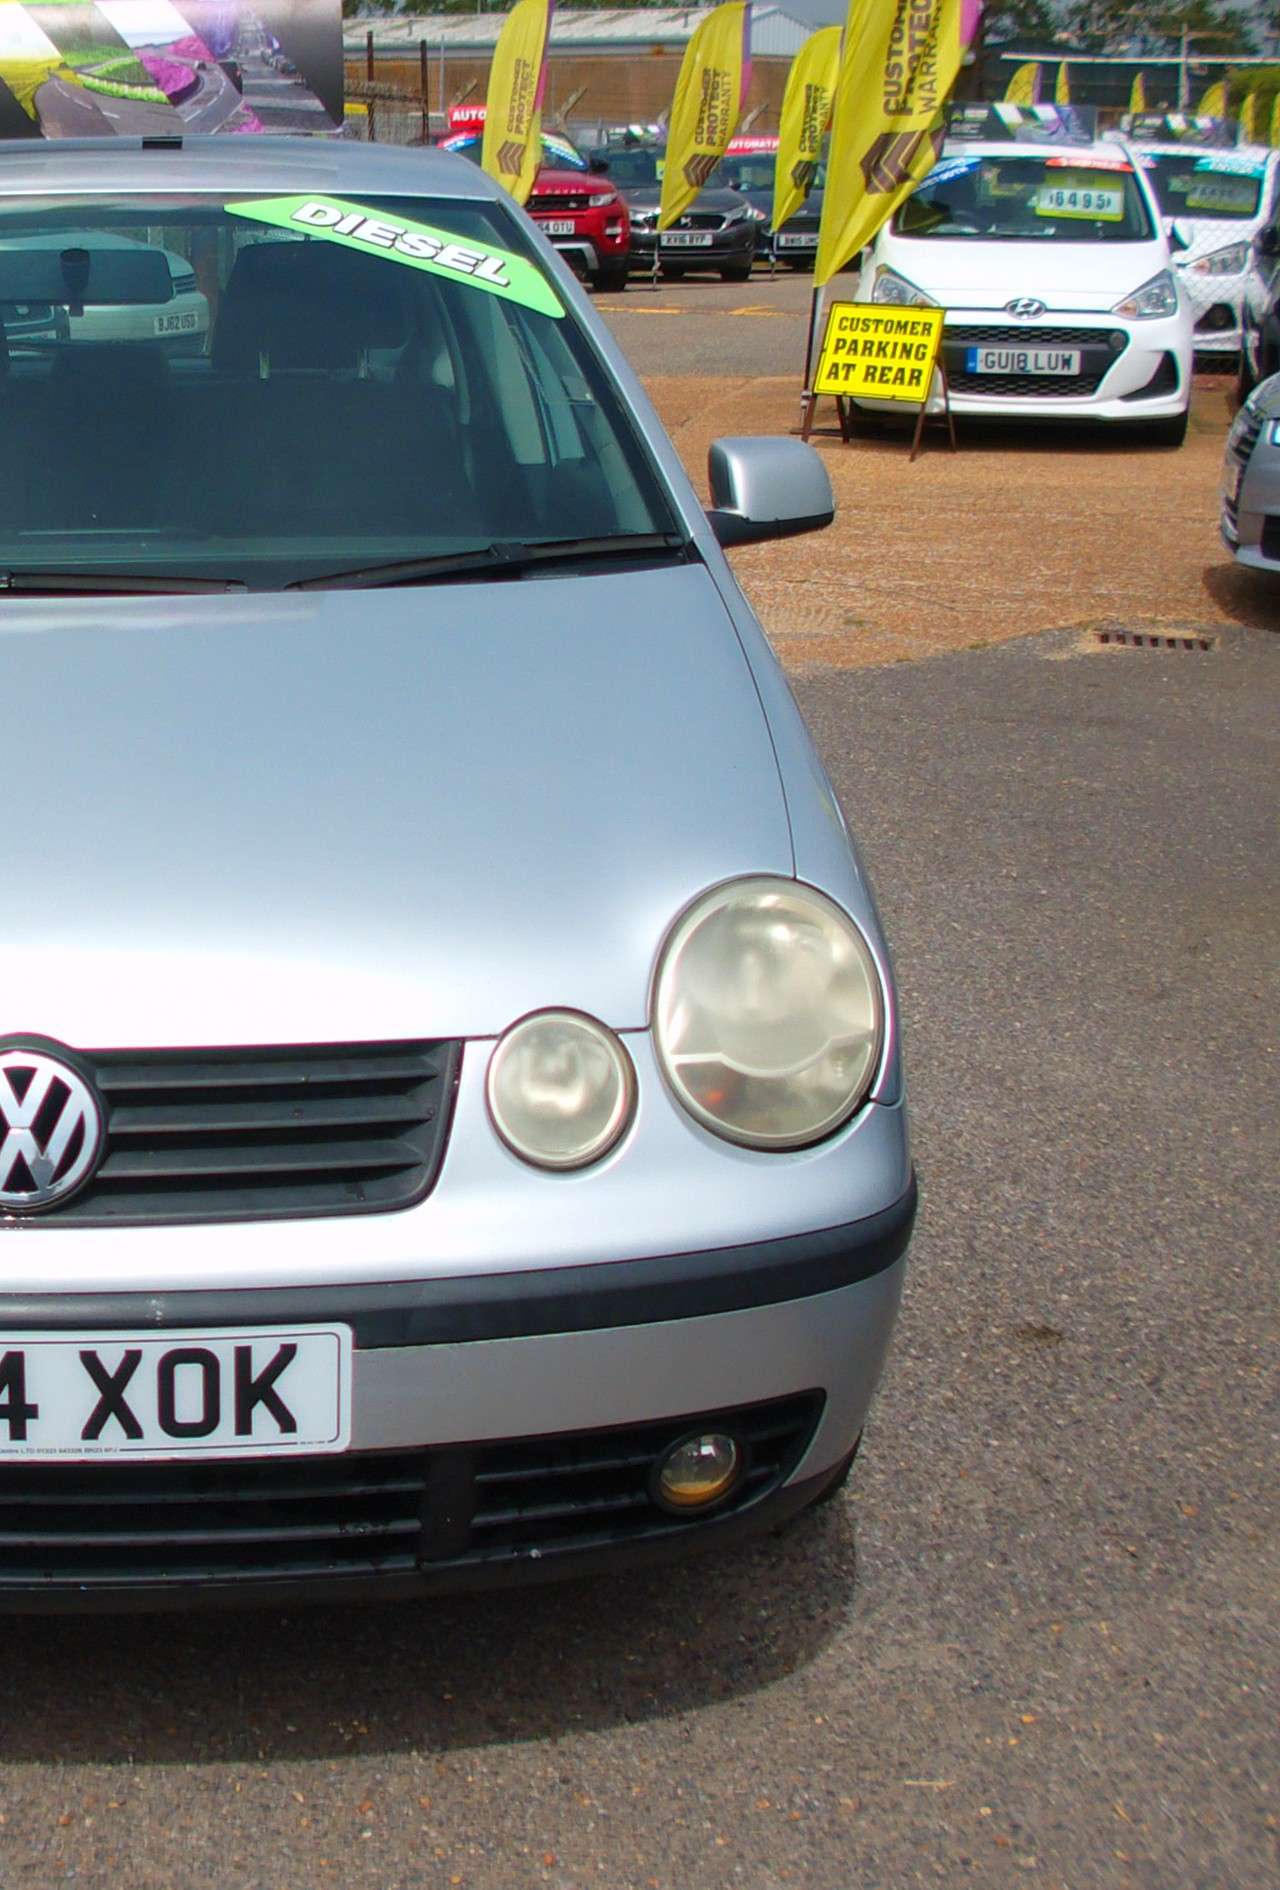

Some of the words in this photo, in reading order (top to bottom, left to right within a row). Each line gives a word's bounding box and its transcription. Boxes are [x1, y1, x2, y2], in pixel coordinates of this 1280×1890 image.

[706, 69, 721, 147] PROTECT
[290, 202, 510, 288] DIESEL
[837, 316, 933, 337] CUSTOMER
[832, 338, 928, 362] PARKING
[984, 352, 1028, 372] GU18
[1034, 353, 1073, 373] LUW
[826, 362, 856, 382] AT
[863, 365, 924, 387] REAR
[78, 1342, 299, 1440] XOK
